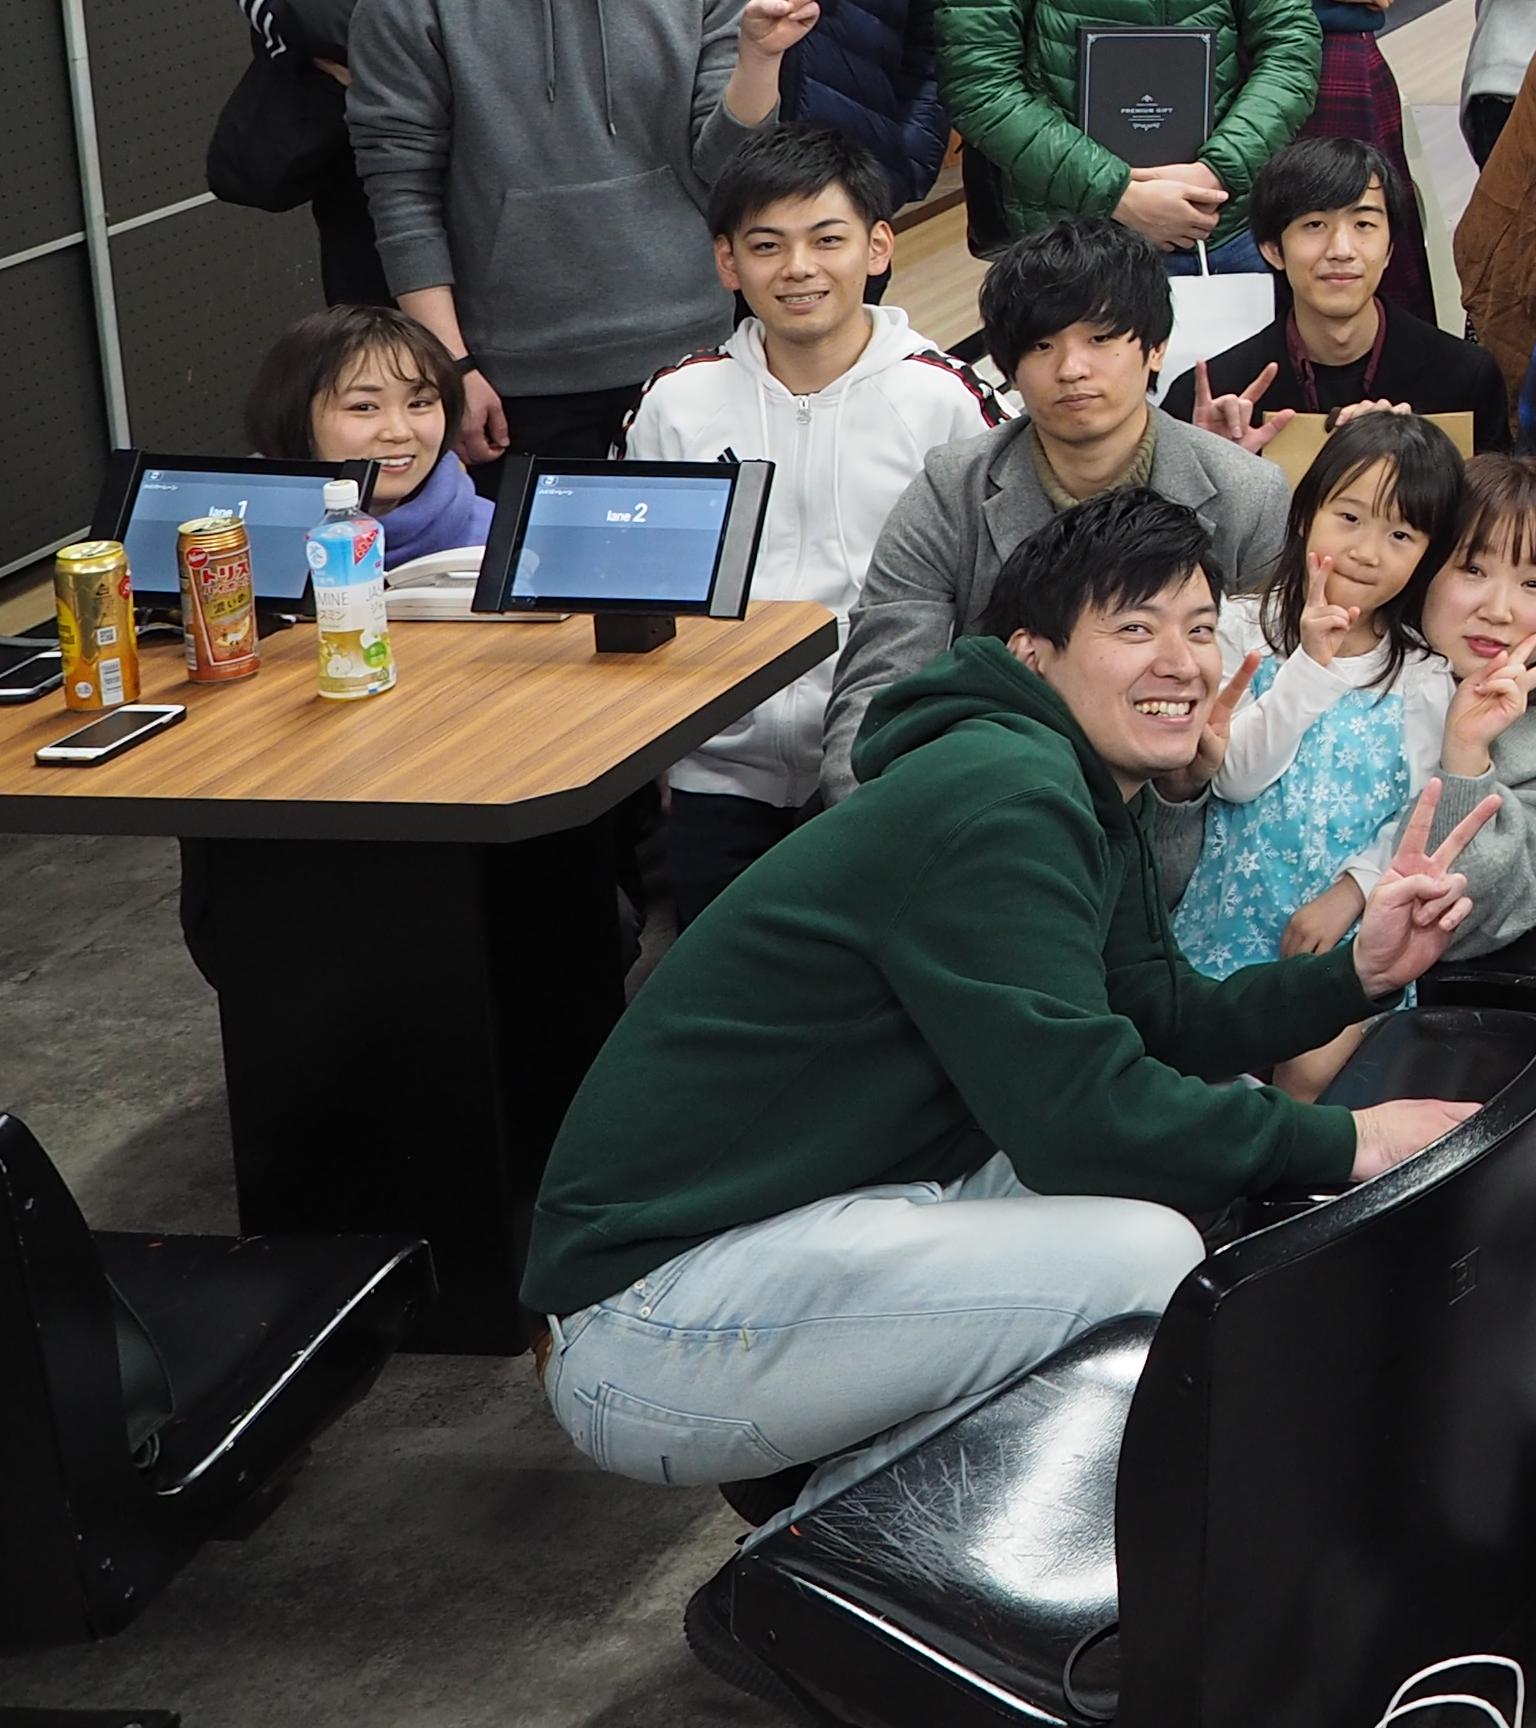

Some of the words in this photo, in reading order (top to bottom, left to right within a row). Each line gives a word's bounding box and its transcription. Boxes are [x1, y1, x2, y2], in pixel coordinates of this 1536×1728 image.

[237, 499, 249, 519] 1
[606, 509, 632, 522] lane
[631, 502, 648, 523] 2
[201, 558, 250, 586] トリス
[317, 591, 350, 607] MINE
[318, 610, 345, 622] スミン
